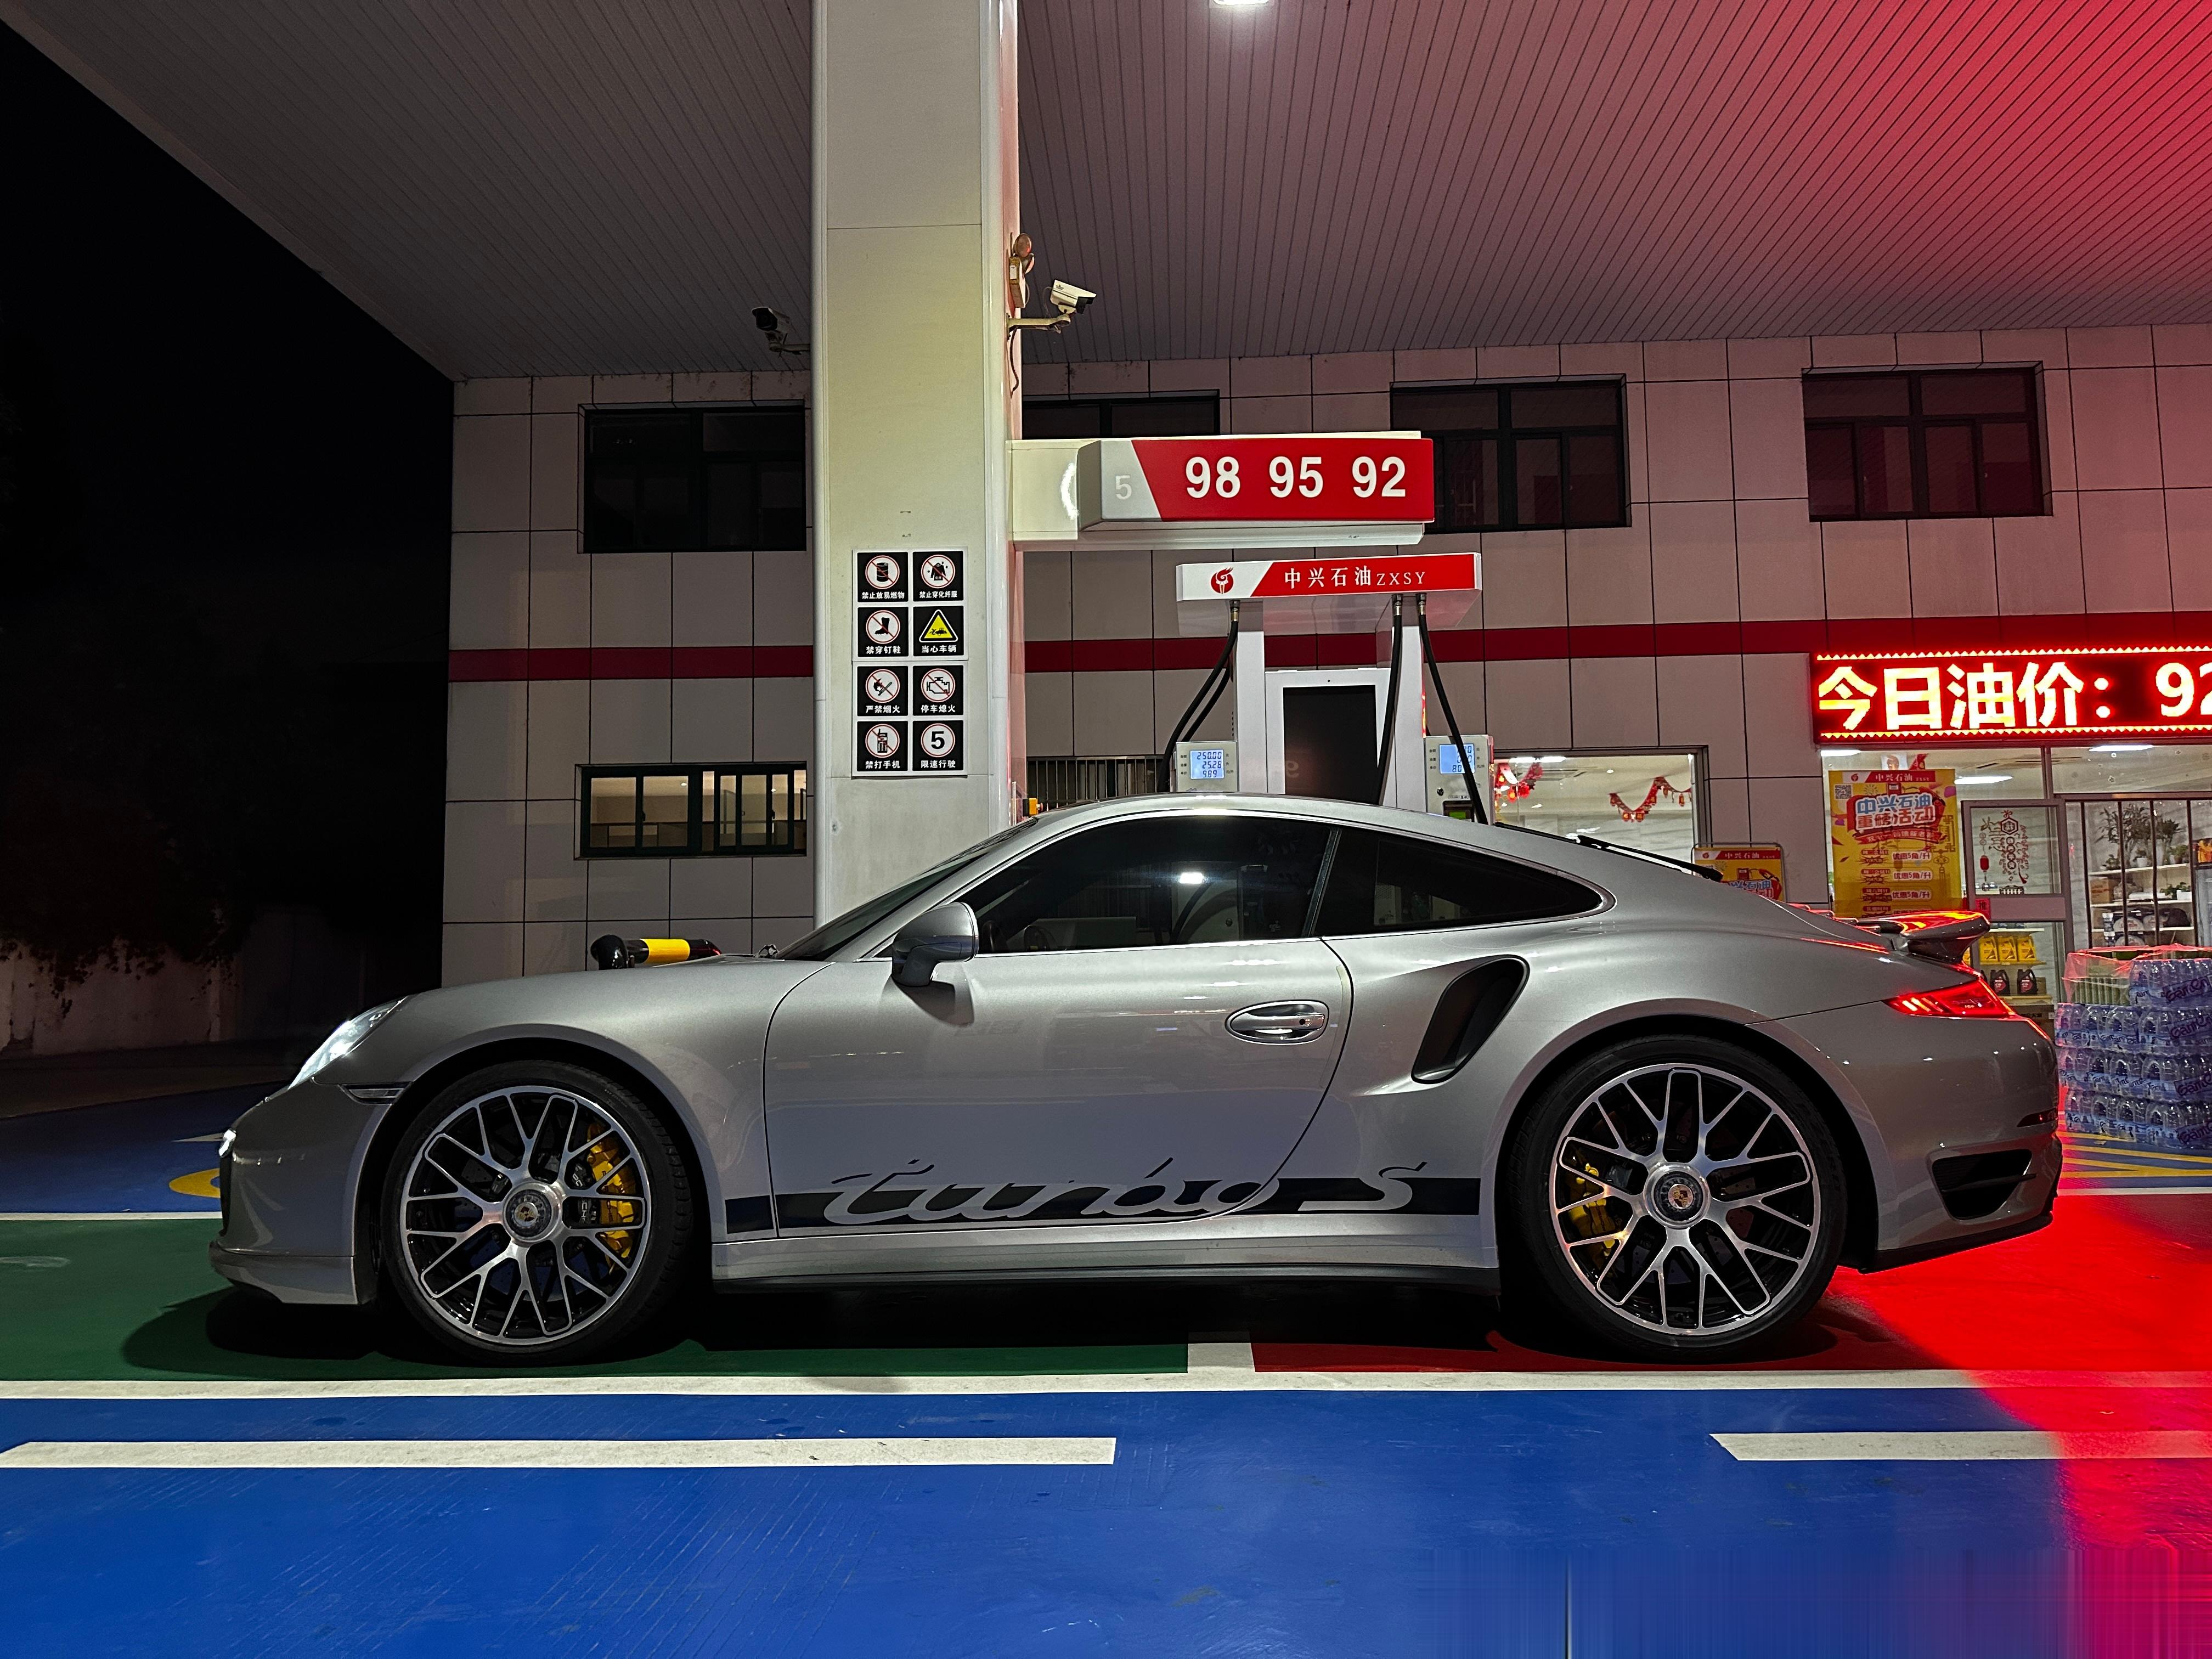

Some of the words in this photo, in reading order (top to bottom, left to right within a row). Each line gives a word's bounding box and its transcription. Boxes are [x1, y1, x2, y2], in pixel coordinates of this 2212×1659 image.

[1186, 456, 1242, 499] 98
[1269, 456, 1324, 499] 95
[1352, 455, 1407, 498] 92
[1115, 475, 1133, 500] 5
[1284, 565, 1372, 590] 中兴石油
[1376, 571, 1427, 587] ZXSY
[861, 591, 905, 600] 禁止放易燃物
[919, 590, 958, 599] 禁止穿化纤服
[866, 645, 901, 654] 禁穿钉鞋
[921, 644, 957, 653] 当心车辆
[1818, 662, 2112, 731] 今日油价：
[865, 704, 900, 713] 严禁烟火
[921, 704, 956, 713] 停车熄火
[930, 731, 945, 749] 5
[1197, 752, 1222, 760] 250.00
[865, 760, 901, 769] 禁打手机
[921, 759, 956, 769] 限速行驶
[1875, 773, 1913, 782] 中兴石油
[1857, 794, 1932, 815] 中兴石油
[1858, 806, 1935, 828] 重磅活动
[823, 1156, 1280, 1225] turbo
[1298, 1161, 1428, 1211] S
